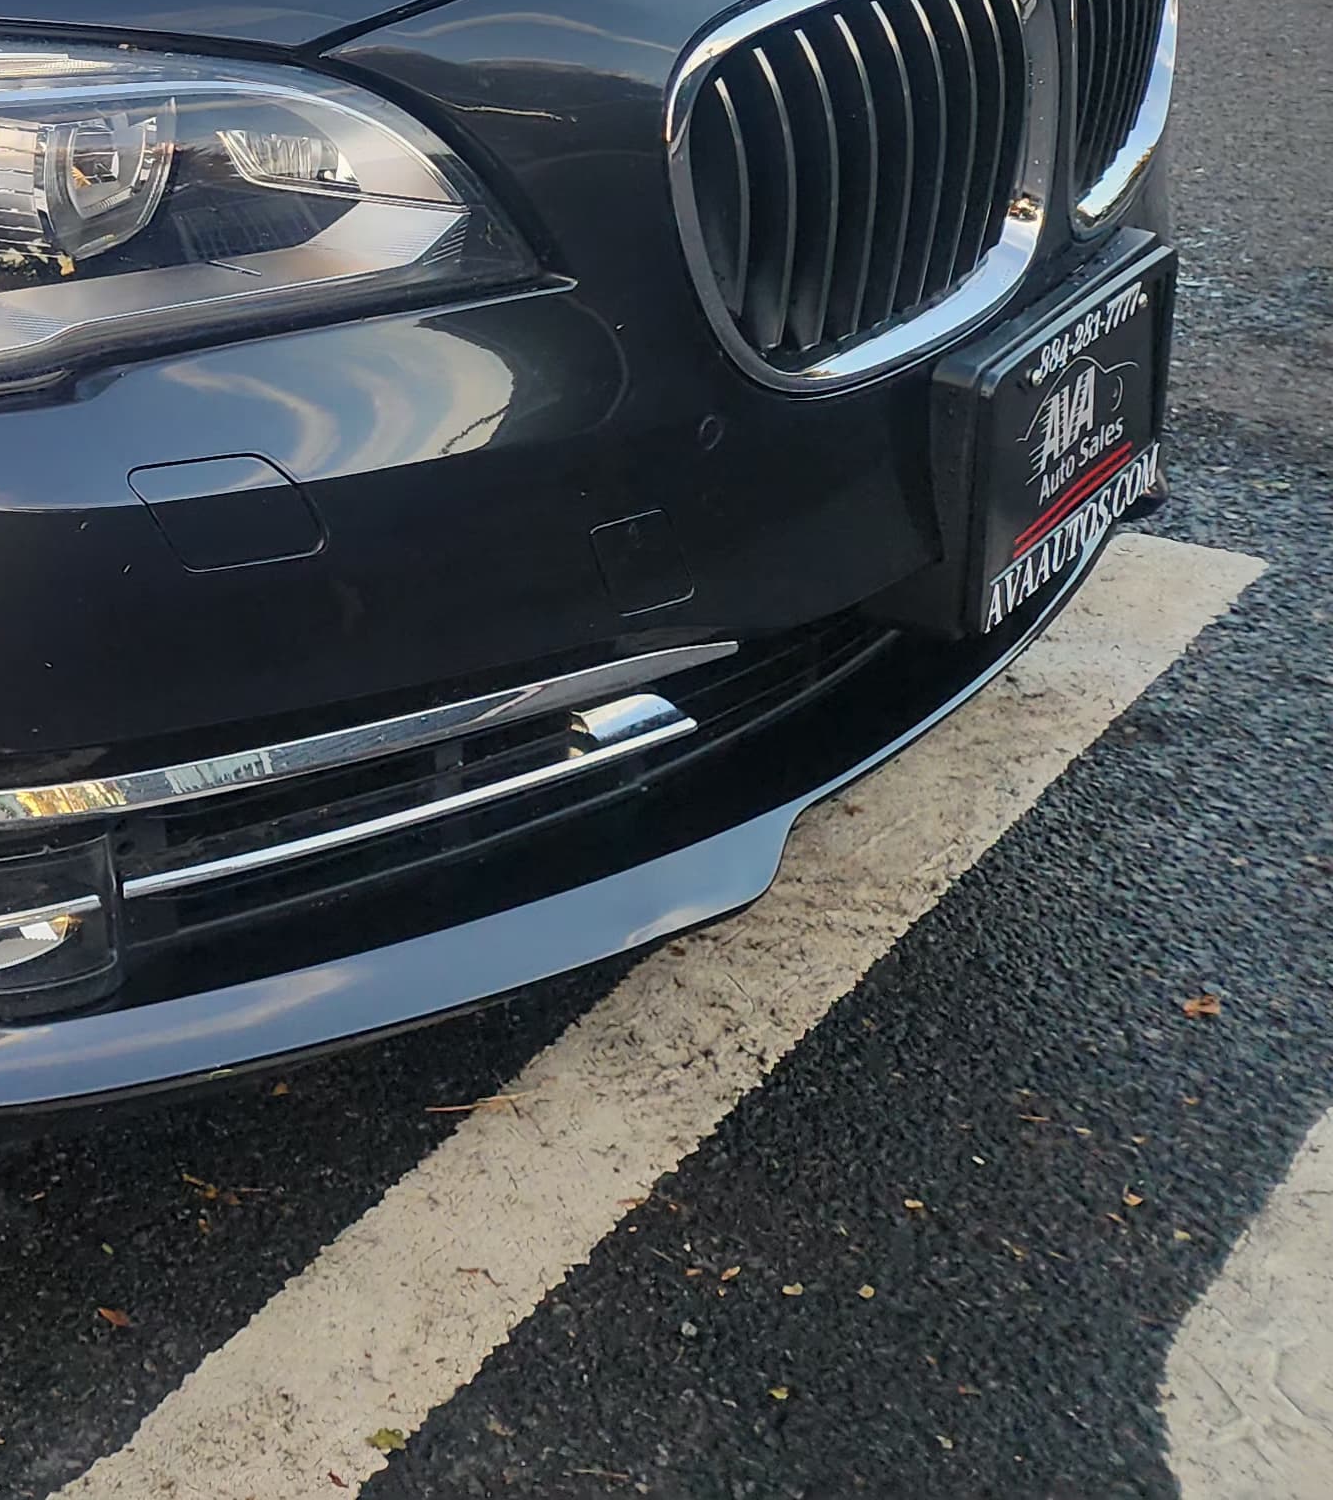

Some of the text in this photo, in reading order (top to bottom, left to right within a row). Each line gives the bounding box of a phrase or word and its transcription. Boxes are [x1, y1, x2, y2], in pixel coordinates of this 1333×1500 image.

[1027, 365, 1096, 486] AVA
[1038, 416, 1124, 506] Auto Sales
[984, 443, 1161, 634] AVAAUTOS.COM
